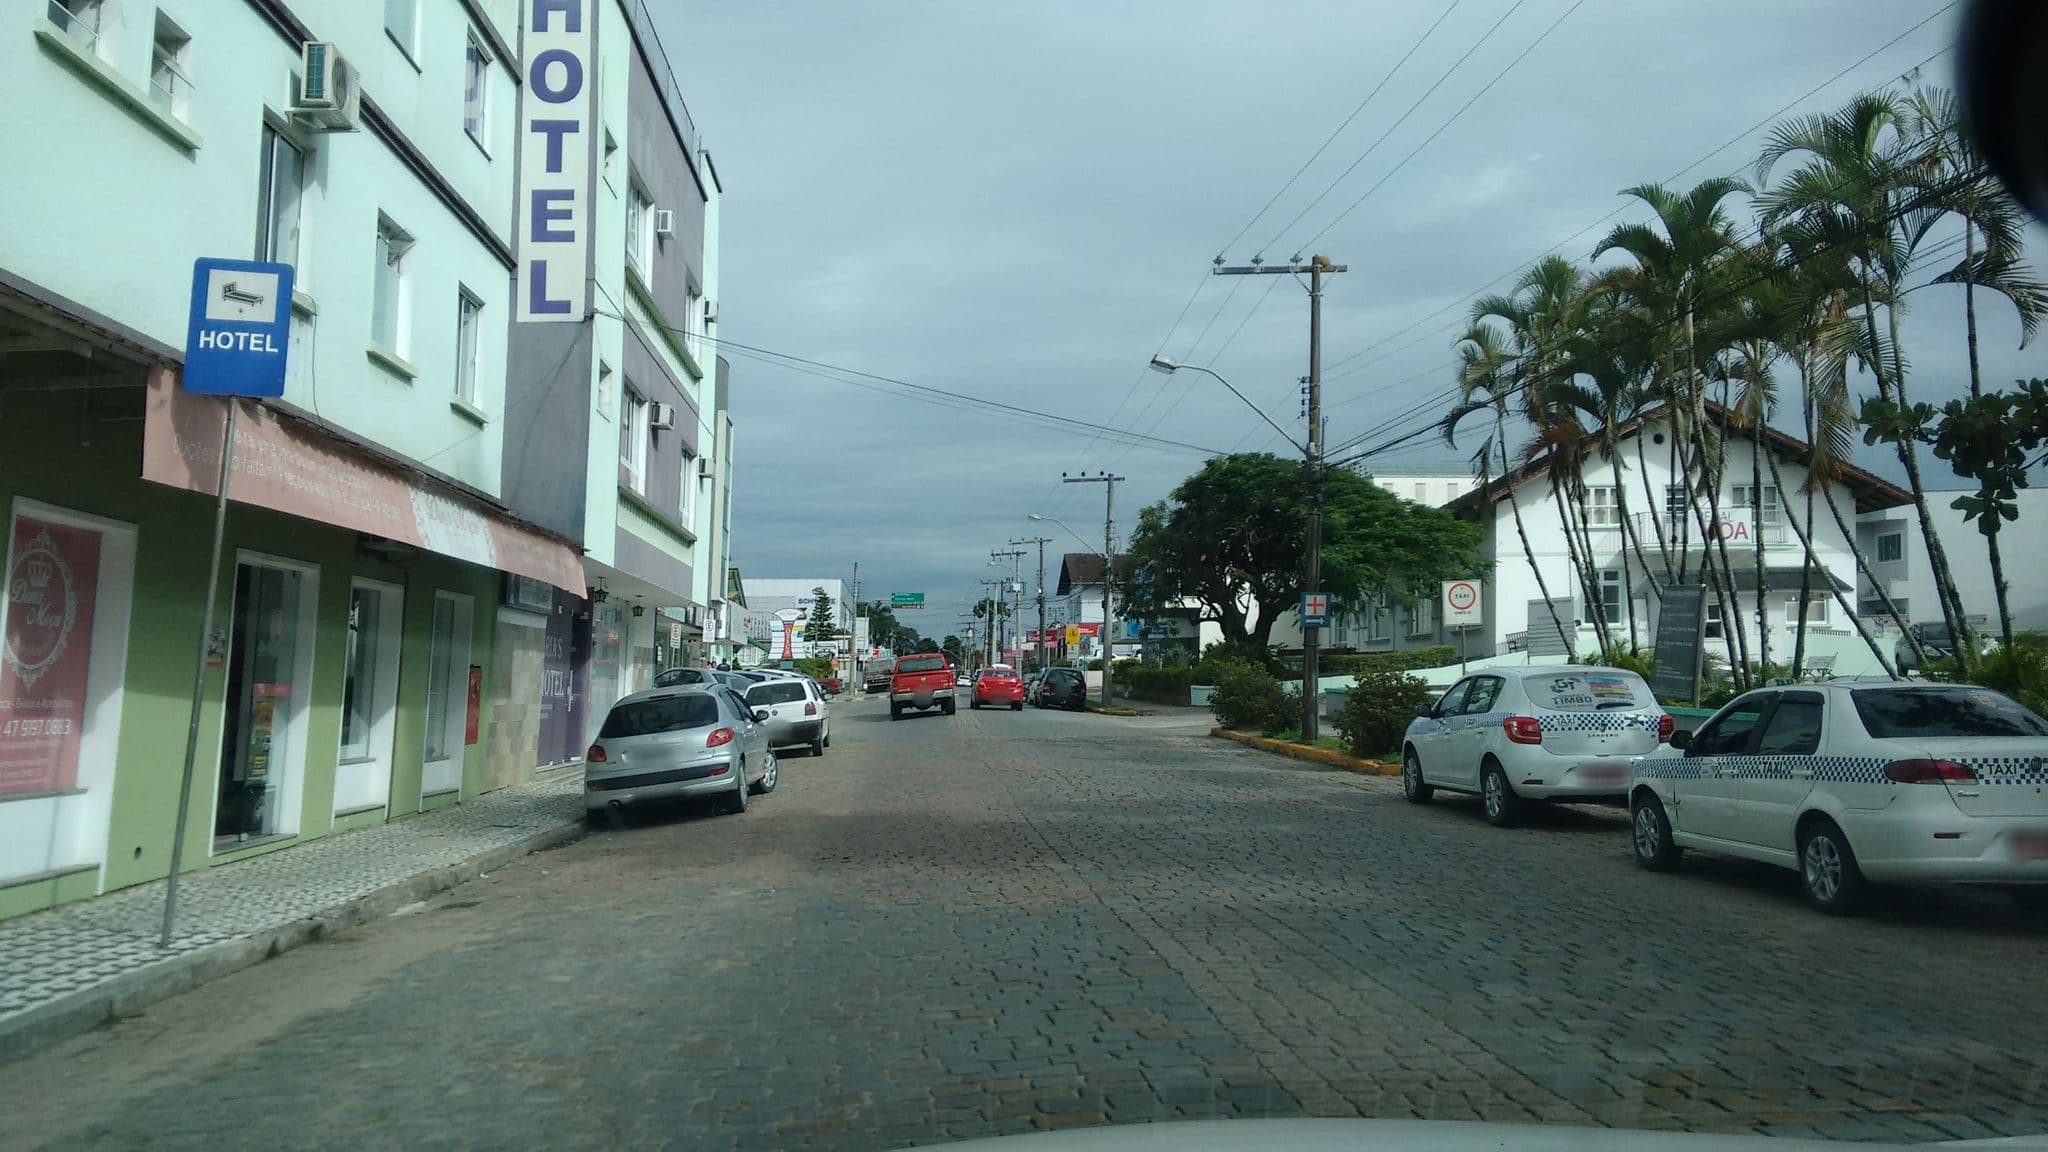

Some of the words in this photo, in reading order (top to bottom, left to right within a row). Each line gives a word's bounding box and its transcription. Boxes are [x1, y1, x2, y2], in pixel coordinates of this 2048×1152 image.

[529, 0, 583, 315] HOTEL
[197, 329, 279, 354] HOTEL
[1556, 717, 1576, 725] TAXI
[1761, 761, 1783, 774] TAXI
[1987, 764, 2017, 775] TAXI
